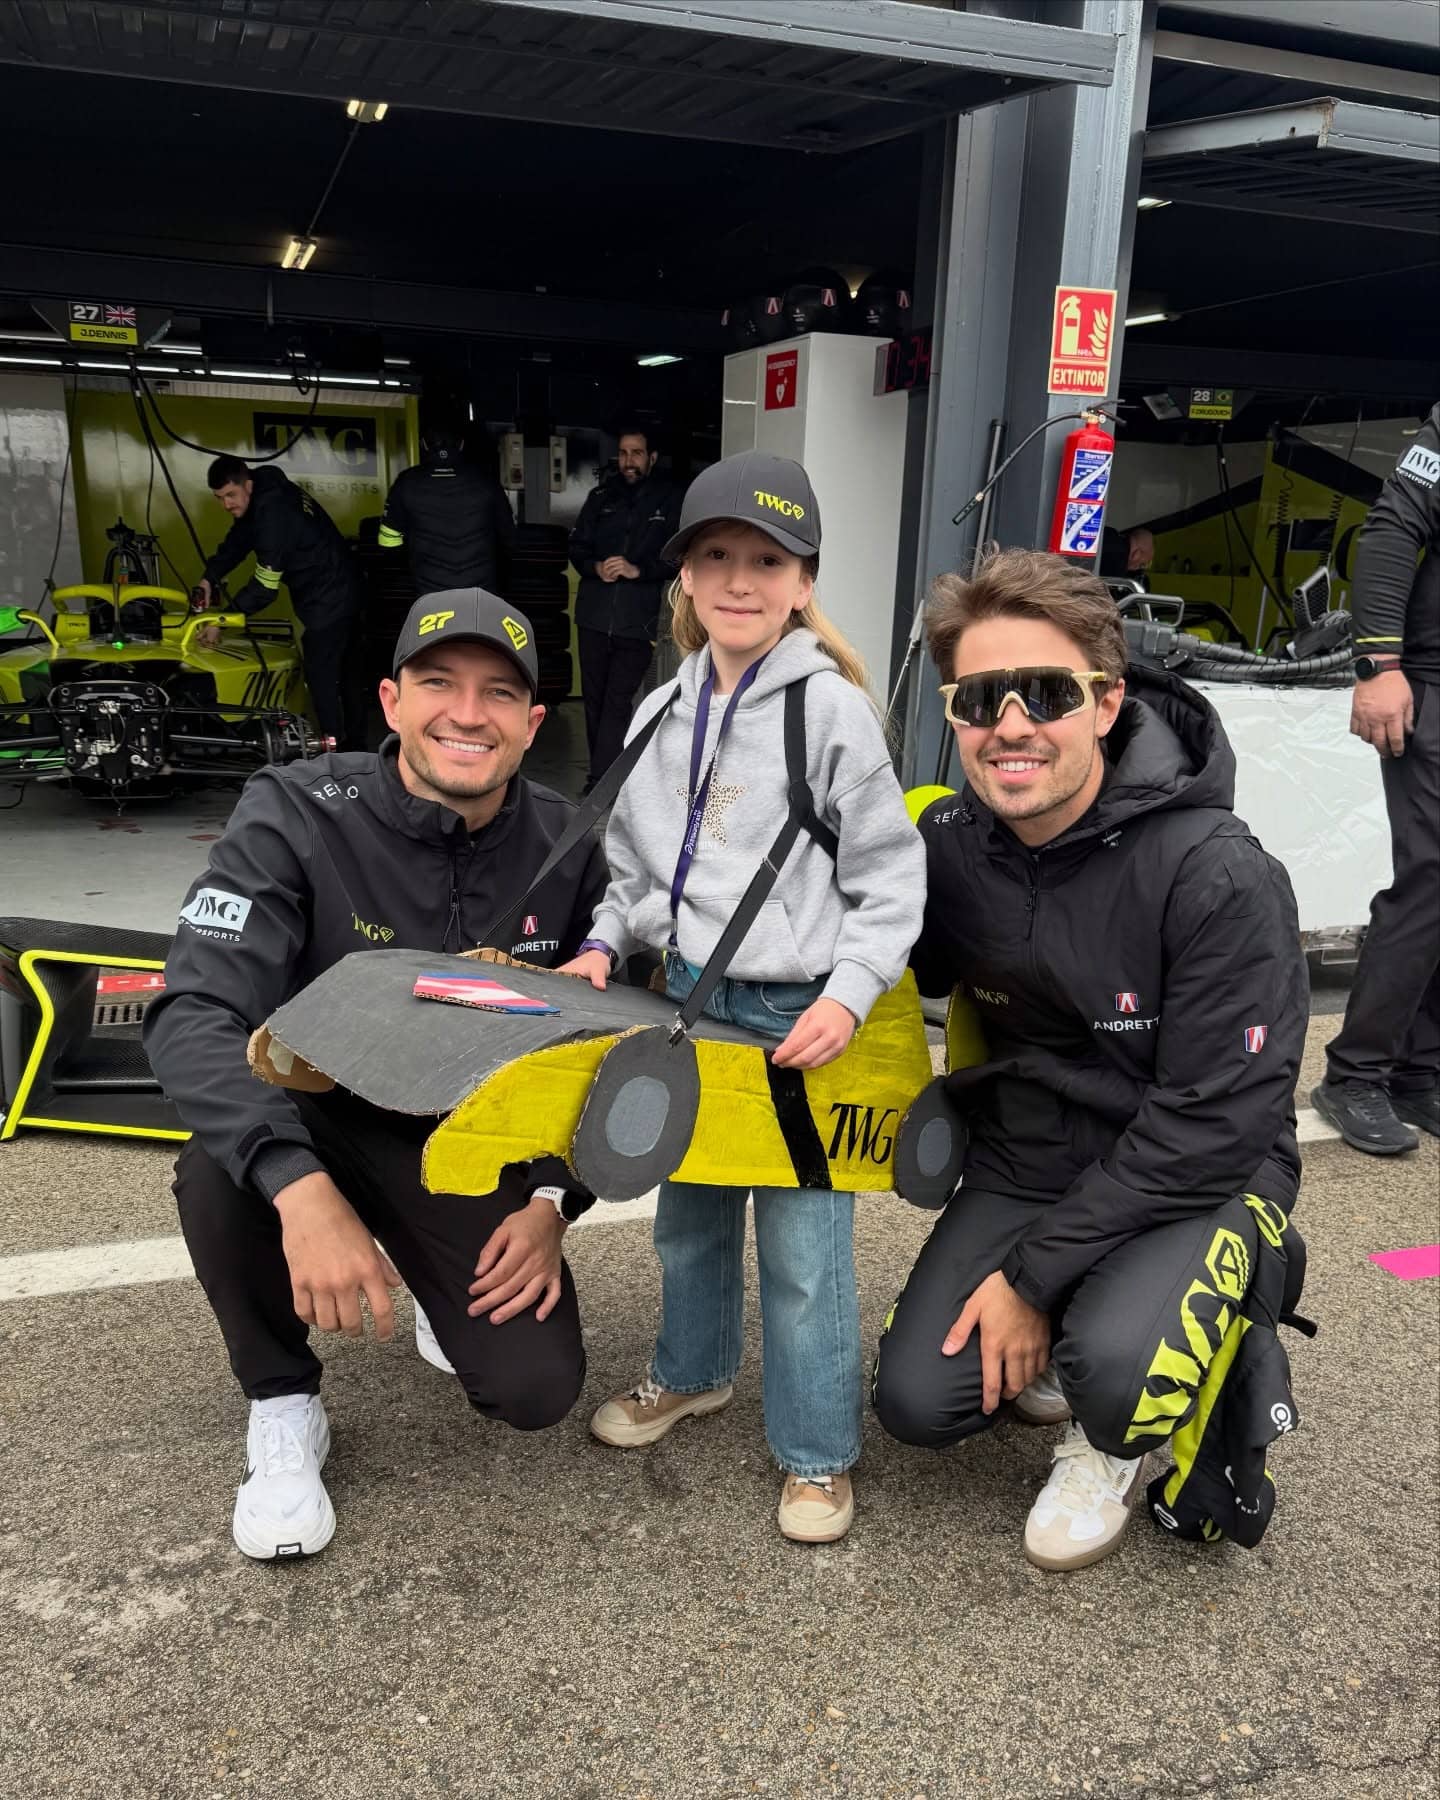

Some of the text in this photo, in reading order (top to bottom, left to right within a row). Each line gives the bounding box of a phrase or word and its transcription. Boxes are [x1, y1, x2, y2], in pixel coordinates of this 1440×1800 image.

[73, 304, 100, 321] 27
[80, 328, 129, 340] J.DENNIS
[1052, 368, 1105, 387] EXTINTOR
[1193, 390, 1211, 402] 28
[754, 490, 793, 516] TWG
[419, 610, 455, 635] 27
[828, 1102, 899, 1165] TWG
